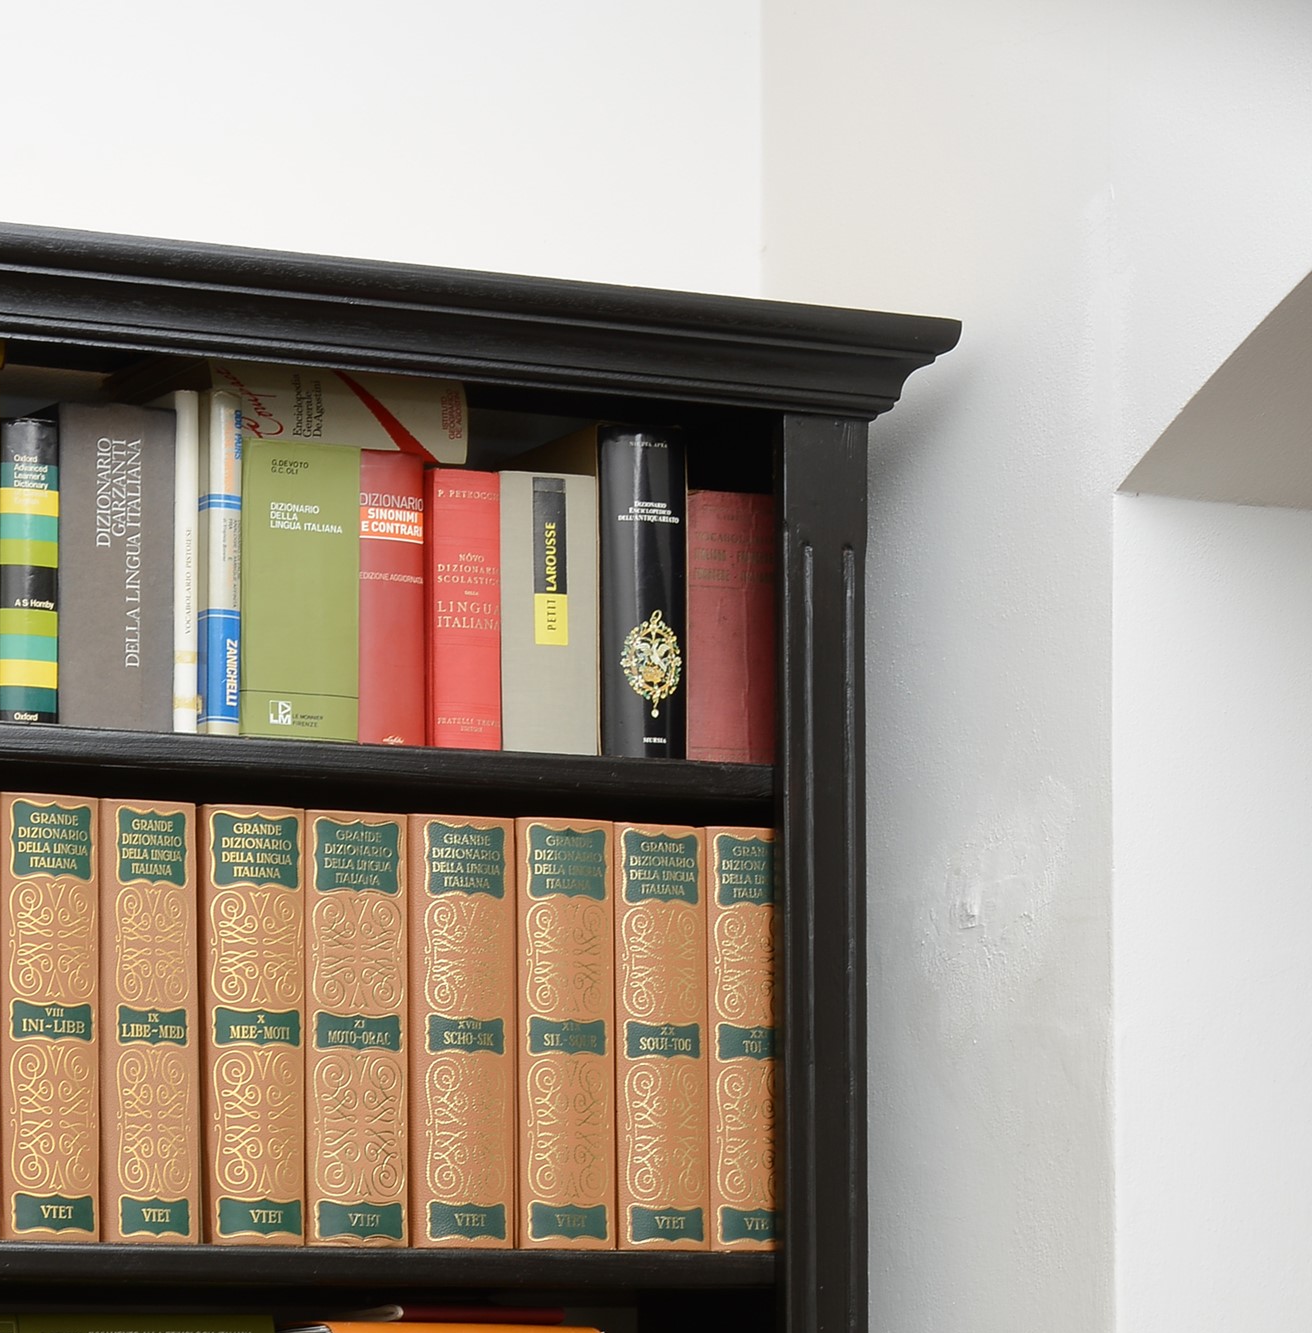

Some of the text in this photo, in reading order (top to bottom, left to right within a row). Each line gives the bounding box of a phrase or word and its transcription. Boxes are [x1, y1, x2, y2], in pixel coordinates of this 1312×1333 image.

[292, 373, 301, 437] Enciclopedia
[302, 391, 312, 438] Generale
[14, 454, 38, 463] Oxford
[14, 480, 48, 490] Dictionary
[96, 438, 111, 548] DIZIONARIO
[111, 438, 127, 537] GARZANTI
[270, 503, 320, 514] DIZIONARIO
[360, 492, 423, 511] DIZIONARIO
[270, 511, 298, 521] DELLA
[367, 508, 418, 523] SINONIMI
[270, 520, 342, 534] LINGUA ITALIANA
[361, 521, 423, 537] E CONTRARI
[126, 438, 142, 668] DELLA LINGUA ITALIANA
[546, 521, 557, 631] PETIT LAROUSSE
[225, 638, 238, 707] ZANICHELLI
[229, 1025, 291, 1040] MEE-MOTI
